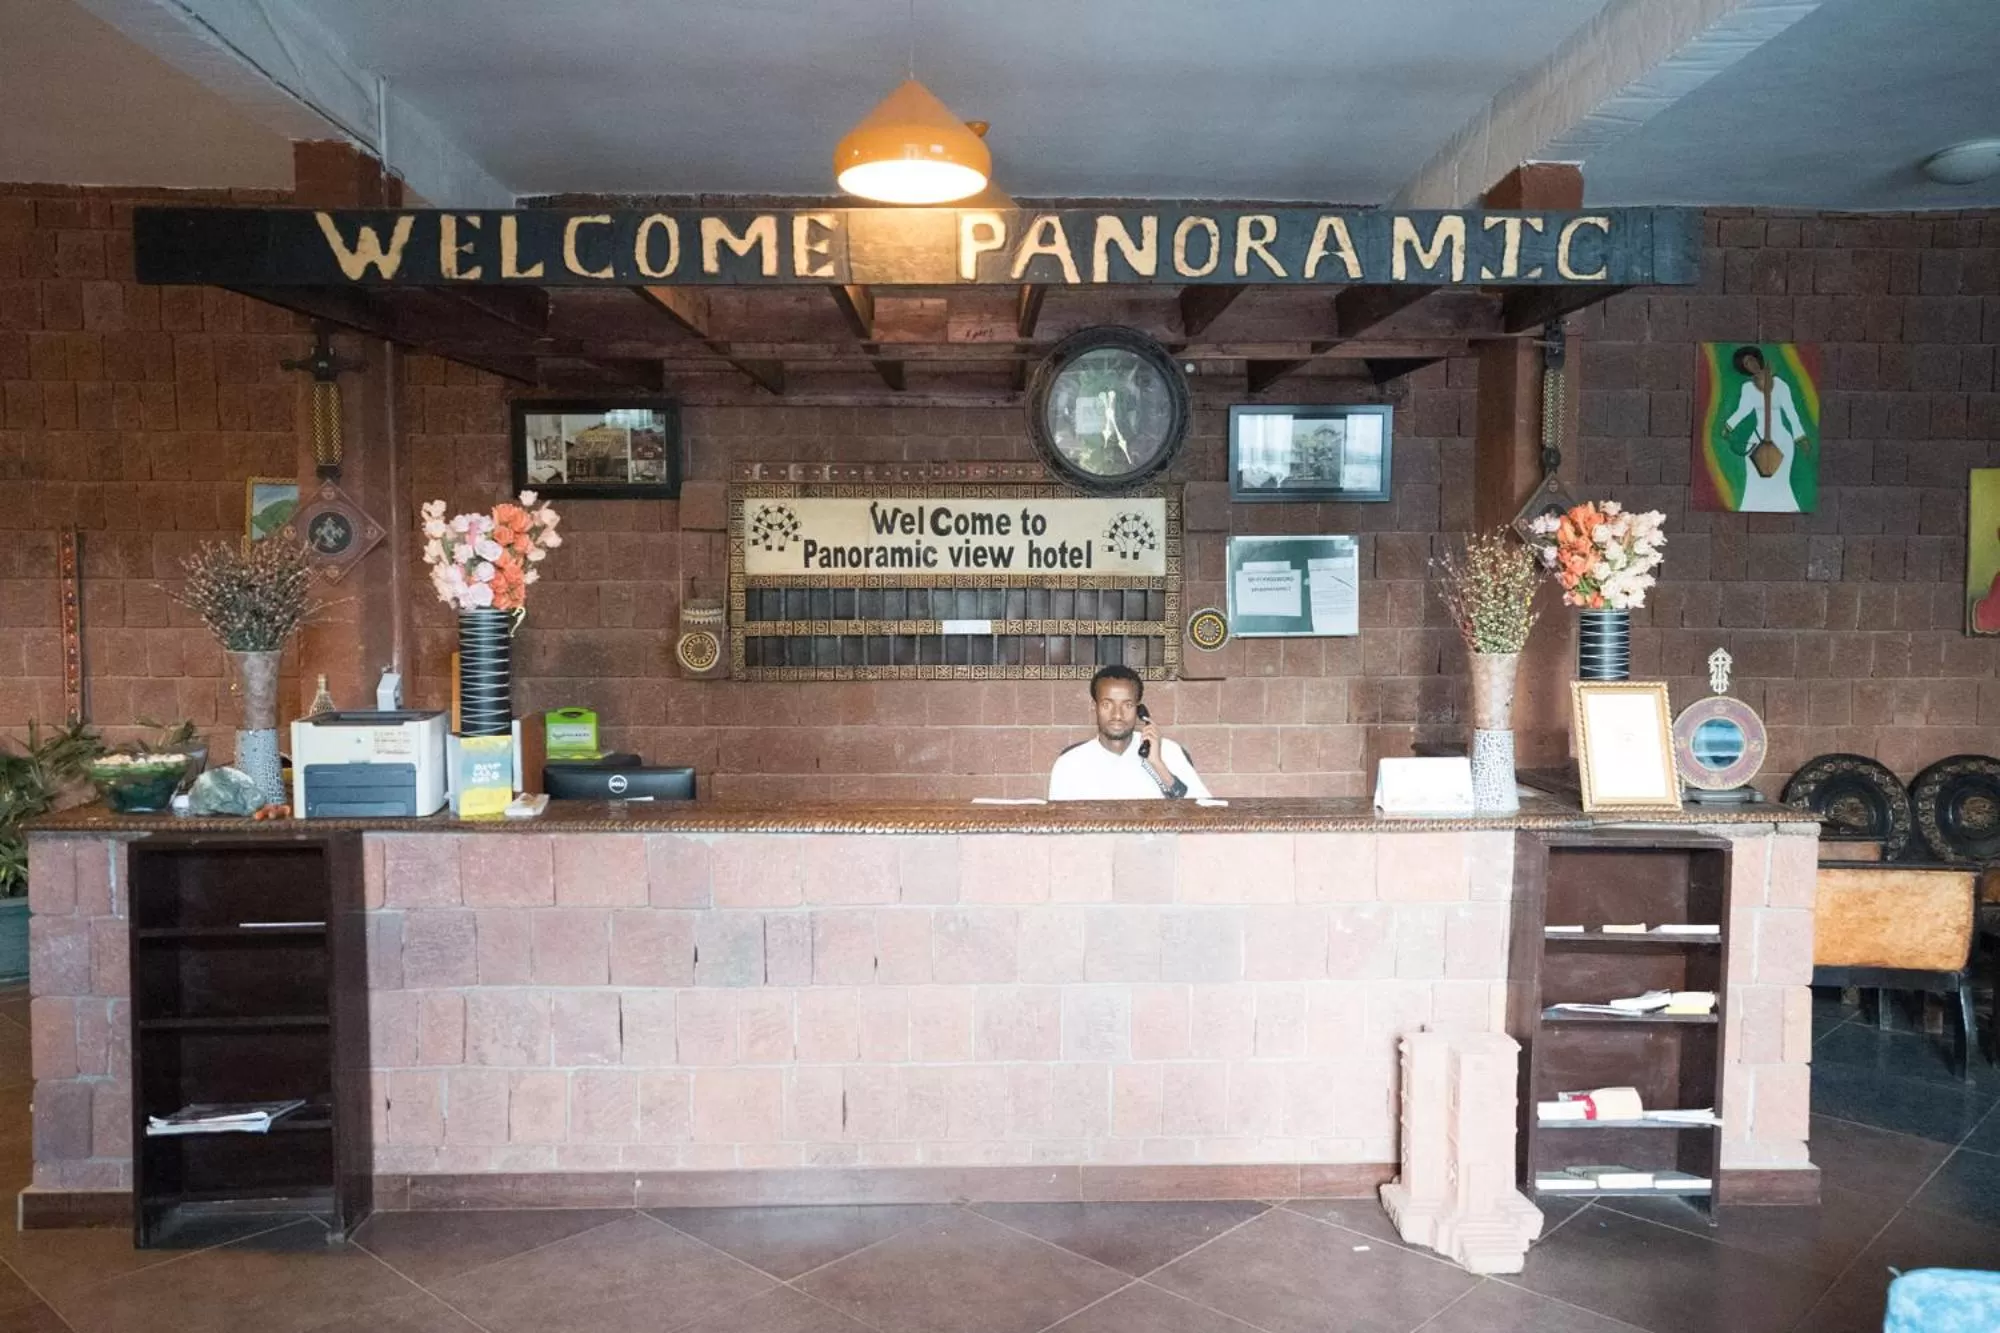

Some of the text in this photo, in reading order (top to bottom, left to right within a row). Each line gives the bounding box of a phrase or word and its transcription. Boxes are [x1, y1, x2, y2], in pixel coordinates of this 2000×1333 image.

[314, 212, 1610, 284] WELCOME PANORAMIC
[1020, 506, 1047, 536] to
[803, 538, 1093, 569] Panoramic view hotel
